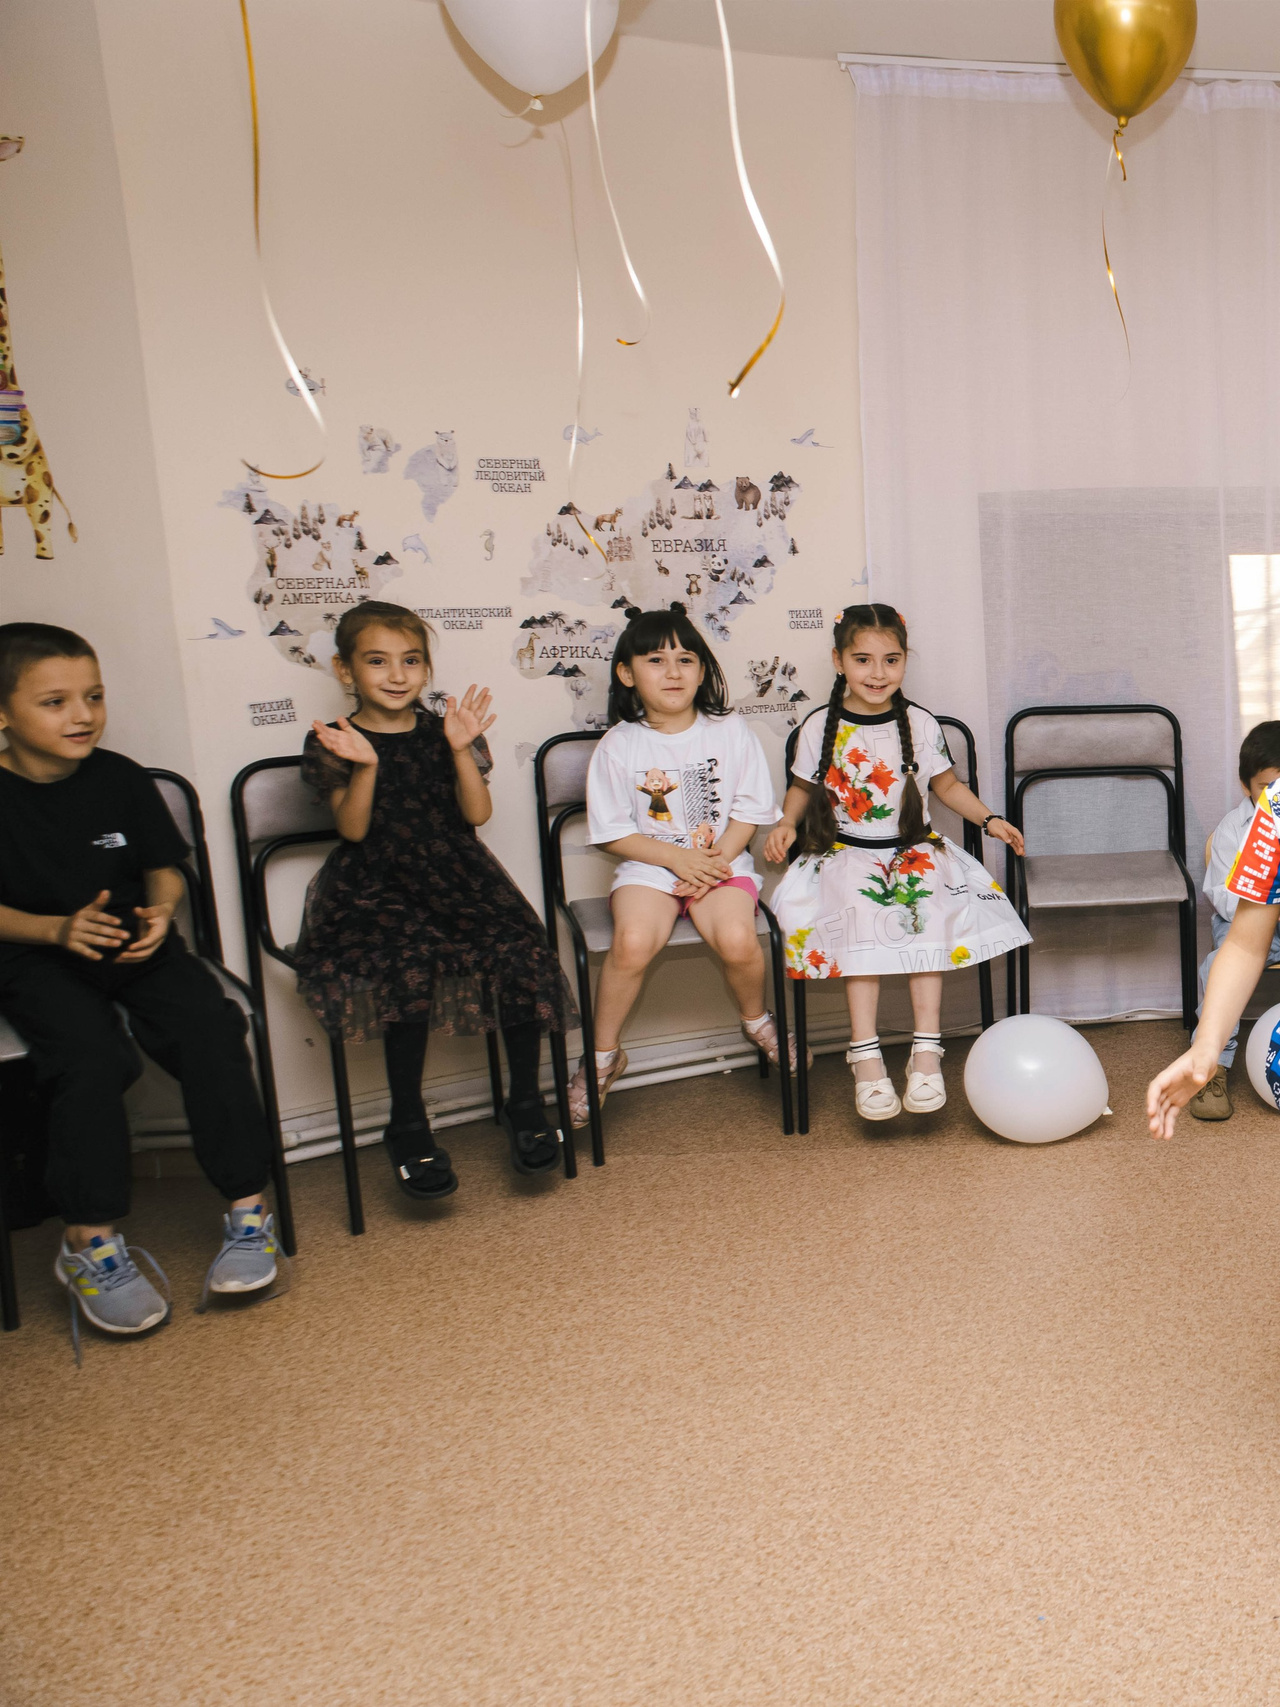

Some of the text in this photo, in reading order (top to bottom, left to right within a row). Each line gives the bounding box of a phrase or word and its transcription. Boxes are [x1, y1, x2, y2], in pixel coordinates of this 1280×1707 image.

[478, 458, 541, 469] СЕВЕРНЫЙ
[475, 470, 546, 481] ЛЕДОВИТЫЙ
[492, 483, 532, 493] ОКЕАН
[651, 539, 727, 553] ЕВРАЗИЯ
[276, 577, 357, 590] СЕВЕРНАЯ
[281, 592, 356, 605] АМЕРИКА
[789, 608, 823, 619] ТИХИЙ
[443, 620, 483, 630] ОКЕАН
[789, 620, 824, 630] ОКЕАН
[539, 645, 603, 659] АФРИКА
[249, 699, 294, 714] ТИХИЙ
[738, 702, 797, 715] АВСТРАЛИЯ
[253, 712, 297, 727] ОКЕАН
